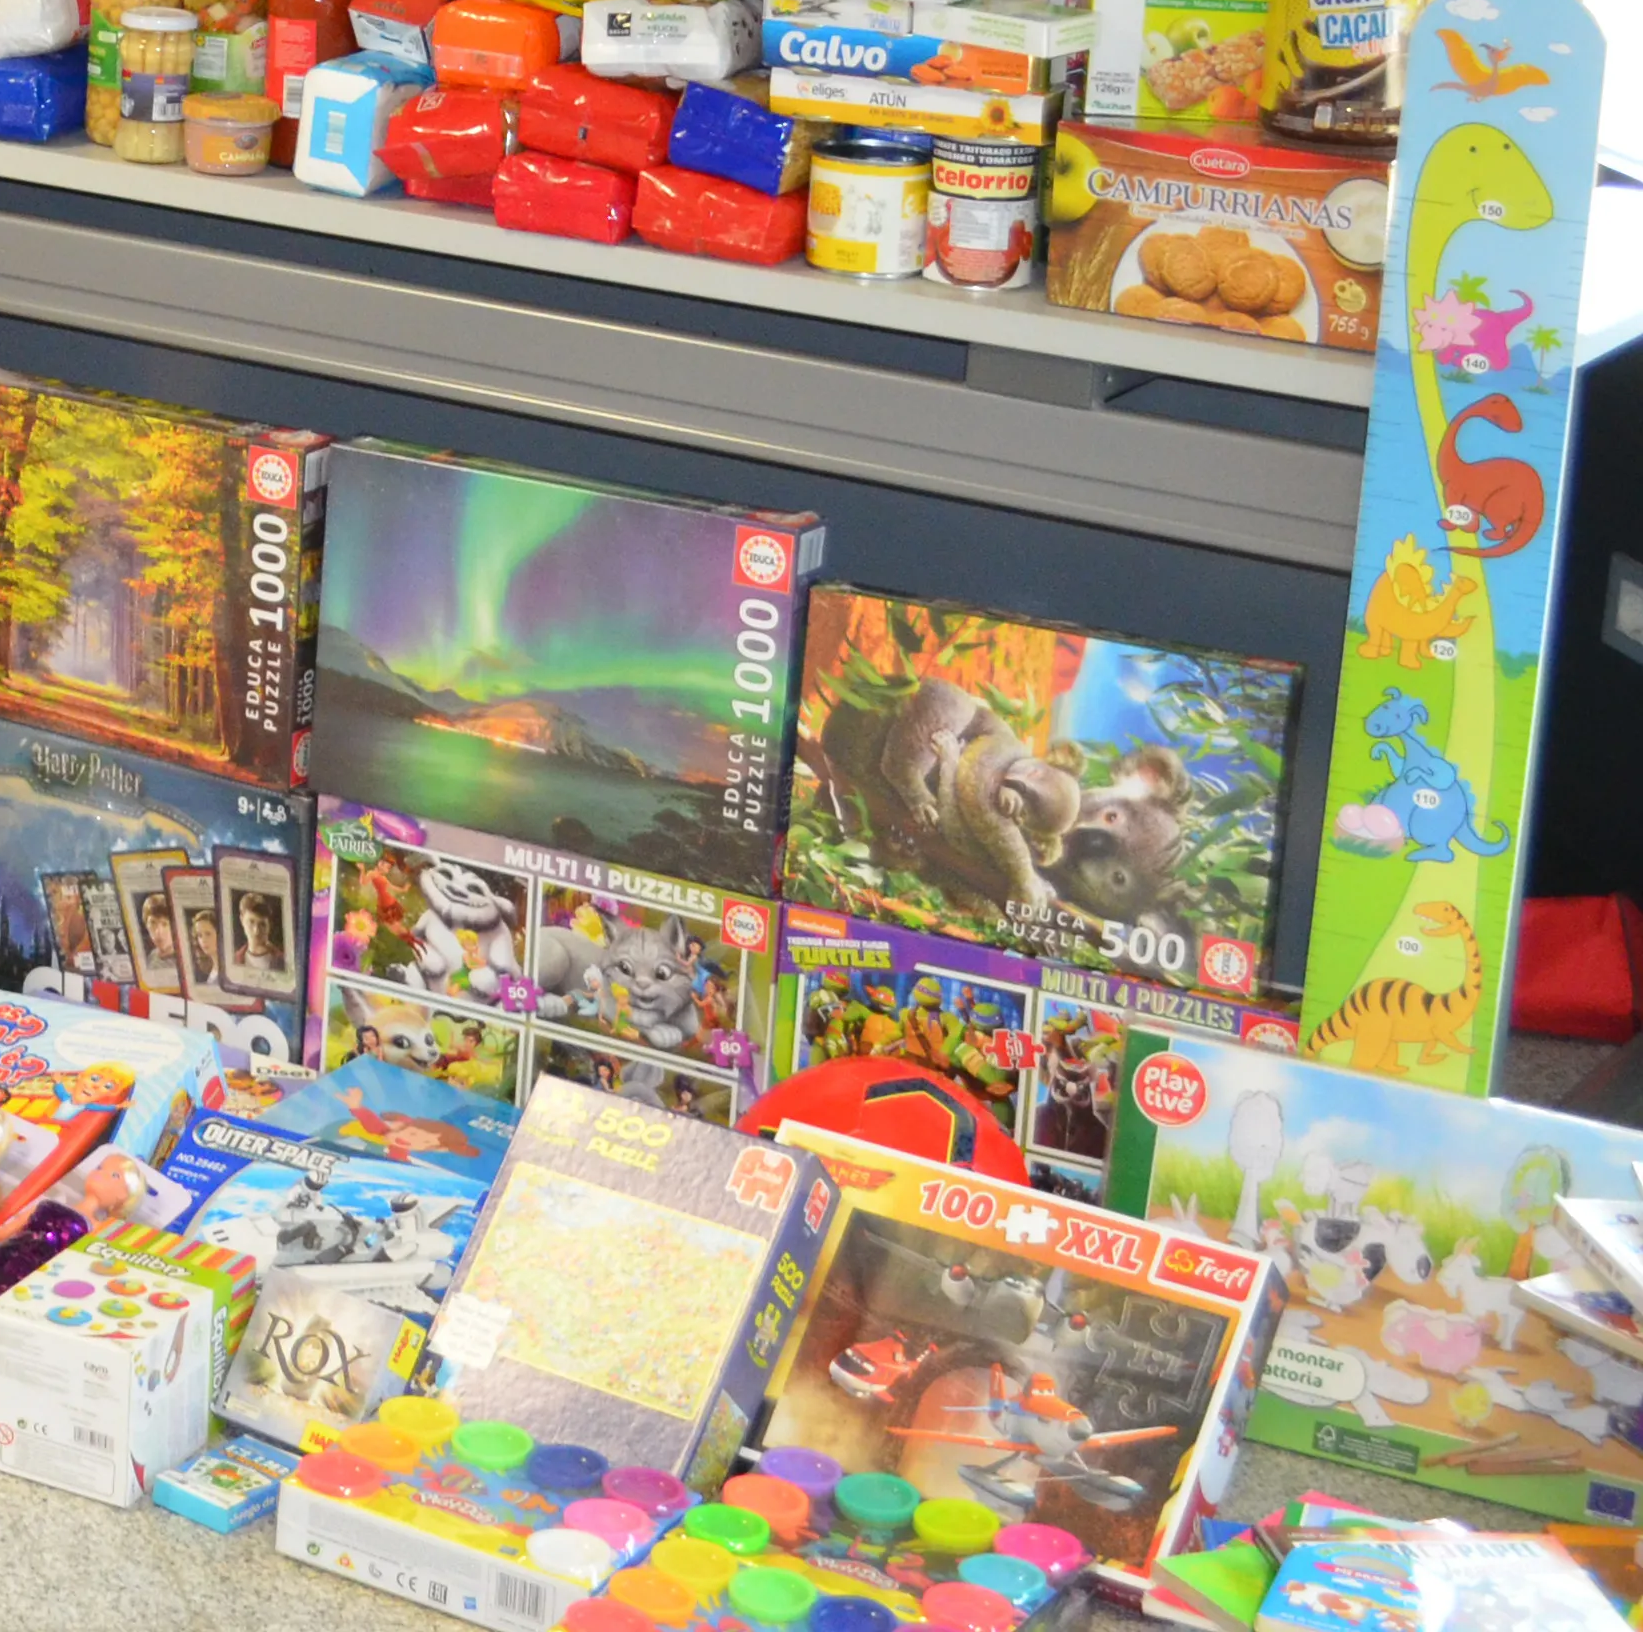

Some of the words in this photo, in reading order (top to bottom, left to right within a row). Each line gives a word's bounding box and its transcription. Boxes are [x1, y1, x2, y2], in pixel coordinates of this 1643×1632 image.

[779, 30, 888, 72] Calvo
[811, 81, 846, 99] eliges
[869, 89, 907, 109] ATÚN
[935, 165, 1028, 191] Celorrio
[1086, 167, 1354, 233] CAMPURRIANAS
[246, 511, 292, 632] 1000
[729, 597, 781, 725] 1000
[1431, 643, 1456, 659] 120
[245, 635, 265, 725] EDUCA
[262, 631, 283, 734] PUZZLE
[722, 730, 744, 822] EDUCA
[743, 730, 766, 833] PUZZLE
[237, 796, 255, 814] 9+
[1412, 790, 1440, 808] 110
[325, 832, 378, 860] FAIRIES
[504, 845, 579, 882] MULTI
[583, 862, 603, 886] 4
[607, 866, 716, 915] PUZZLES
[996, 918, 1087, 951] PUZZLE
[1005, 900, 1087, 932] EDUCA
[789, 945, 893, 970] TURTLES
[1099, 923, 1187, 971] 500
[1396, 939, 1421, 956] 100
[1041, 967, 1108, 1004] MULTI
[1116, 984, 1129, 1008] 4
[1135, 987, 1236, 1033] PUZZLES
[719, 1039, 742, 1056] 80
[255, 1066, 313, 1080] Diset
[1143, 1065, 1199, 1099] Play
[201, 1121, 270, 1157] OUTER
[269, 1140, 336, 1173] SPACE
[593, 1105, 672, 1149] 500
[918, 1181, 996, 1232] 100
[1054, 1218, 1145, 1274] XXL
[1192, 1252, 1250, 1292] Trefl
[250, 1310, 372, 1396] ROX
[1276, 1346, 1345, 1375] montar
